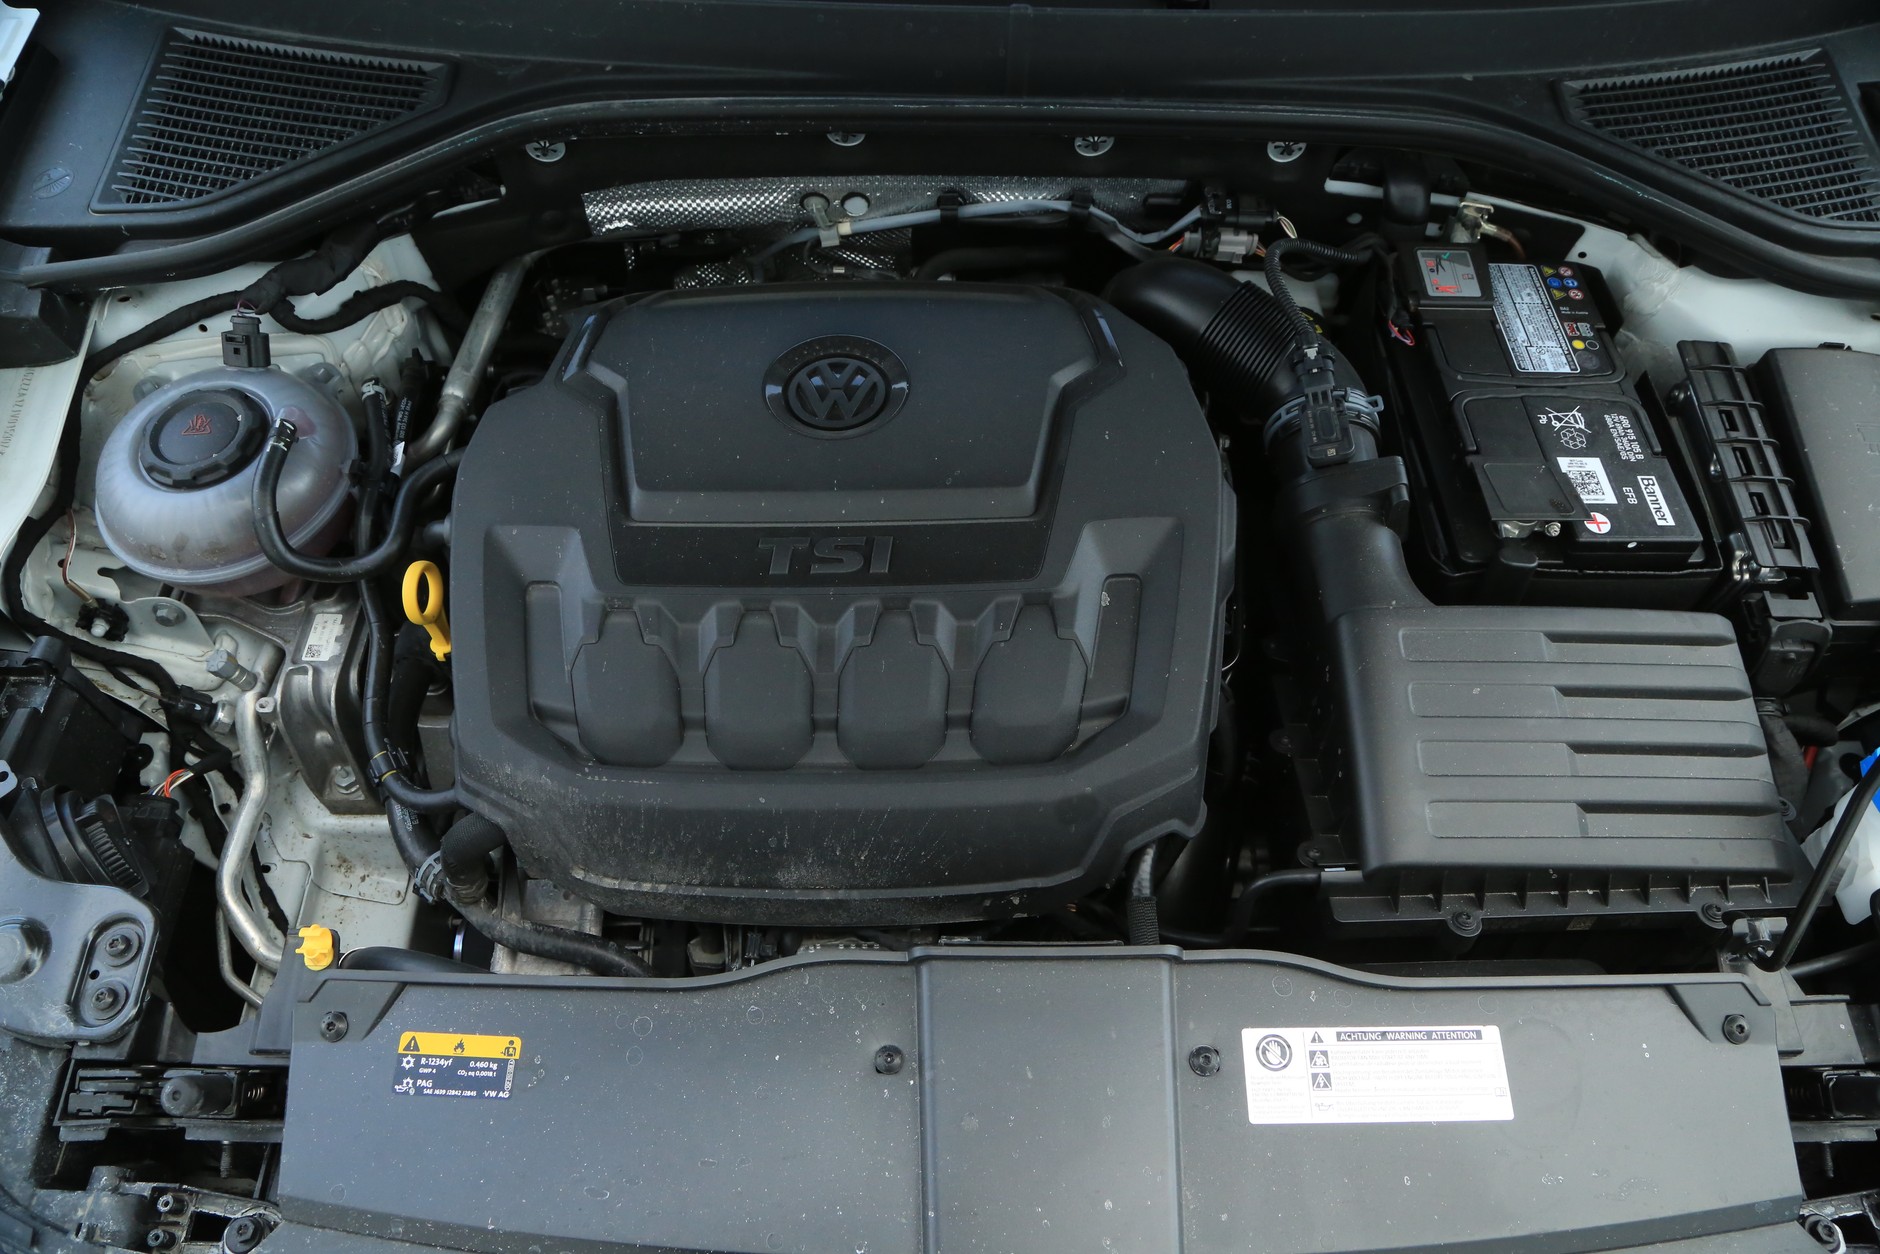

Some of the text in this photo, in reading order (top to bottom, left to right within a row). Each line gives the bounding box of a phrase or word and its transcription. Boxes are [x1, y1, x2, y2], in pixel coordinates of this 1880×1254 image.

[1537, 414, 1548, 424] Pb
[1619, 416, 1630, 427] 6R0
[1611, 414, 1620, 422] 12V
[1627, 452, 1636, 461] DIN
[1625, 429, 1636, 439] 915
[1630, 442, 1641, 452] 105
[1623, 486, 1638, 504] EFB
[1640, 478, 1670, 524] Banner
[758, 536, 894, 574] TSI
[1340, 1031, 1477, 1041] ACHTUNG WARNING ATTENTION
[421, 1058, 453, 1068] R-1234yf
[490, 1062, 498, 1070] kg
[416, 1080, 432, 1088] PAG
